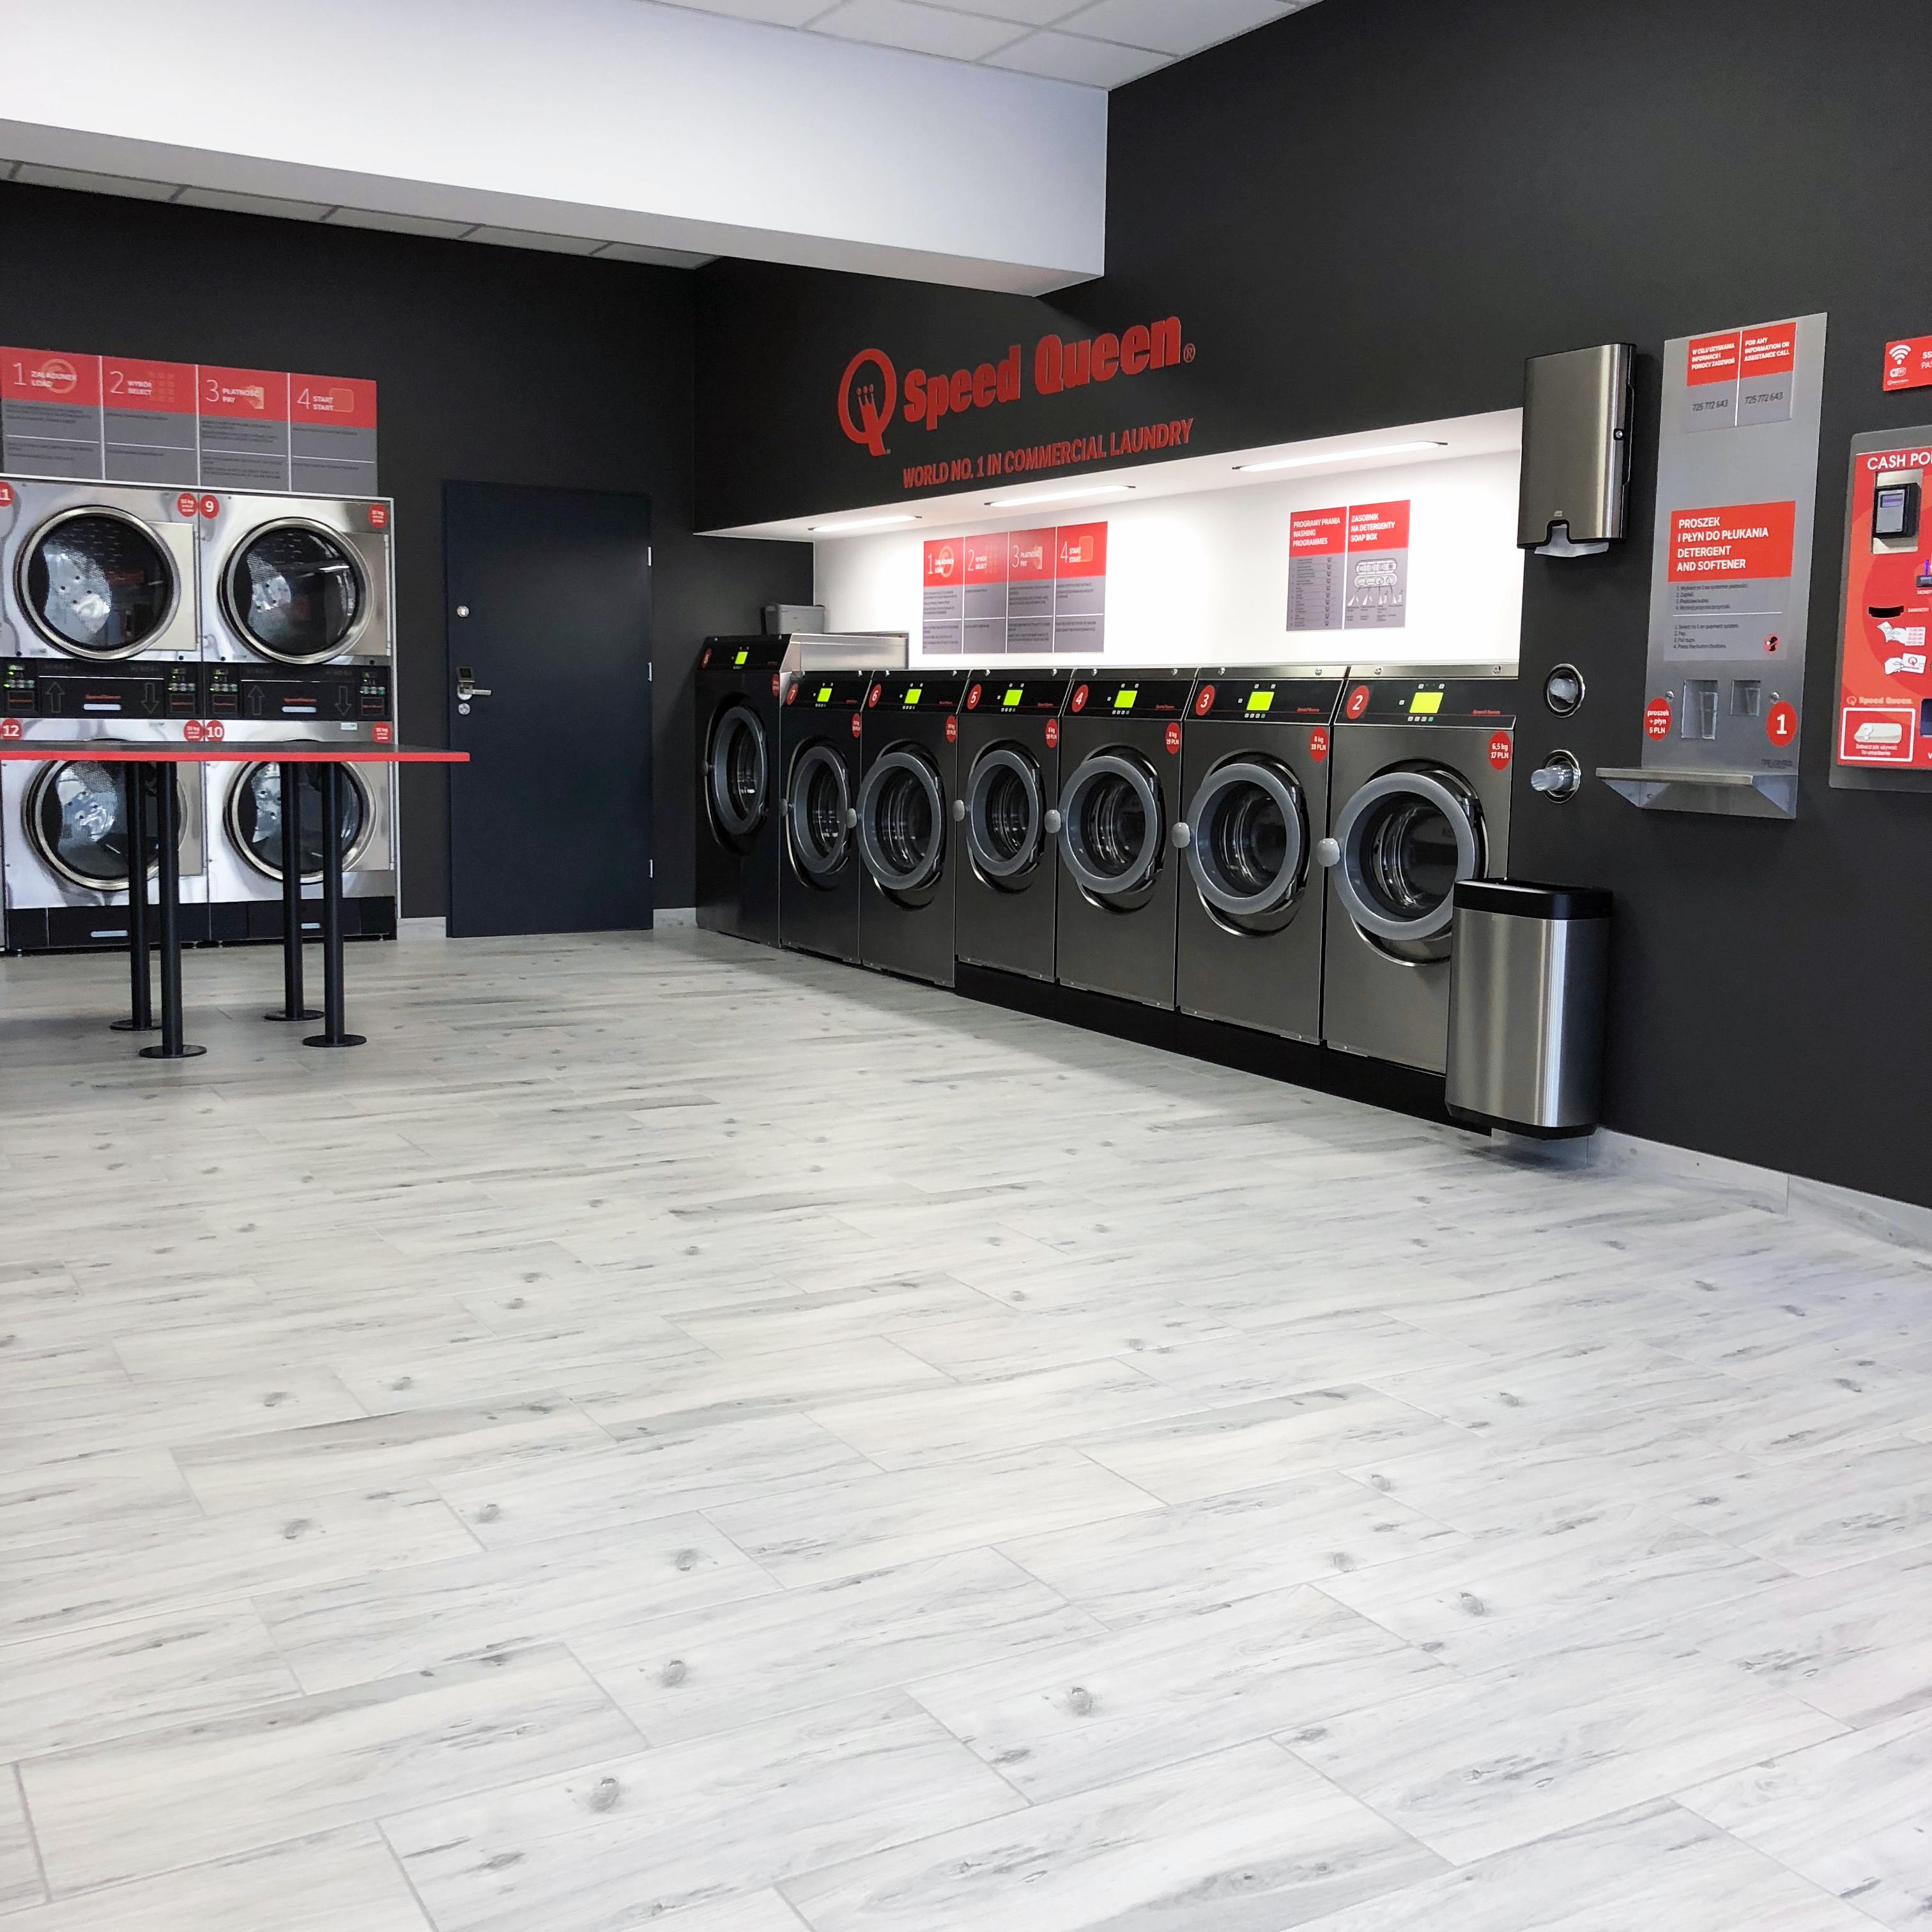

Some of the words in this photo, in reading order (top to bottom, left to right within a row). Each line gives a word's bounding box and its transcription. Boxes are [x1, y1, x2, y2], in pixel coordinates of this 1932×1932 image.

[1745, 342, 1781, 354] INFORMATION
[1744, 351, 1776, 362] ASSISTANCE
[13, 362, 26, 385] 1
[903, 344, 1021, 431] Speed
[1034, 316, 1181, 395] Queen
[110, 371, 125, 394] 2
[206, 379, 219, 402] 3
[297, 388, 310, 409] 4
[312, 395, 334, 404] START
[1745, 395, 1757, 404] 725
[1758, 394, 1769, 402] 772
[312, 403, 334, 411] START
[1692, 403, 1704, 411] 725
[1705, 401, 1715, 410] 772
[903, 463, 948, 489] WORLD
[951, 458, 973, 481] NO.
[977, 456, 985, 478] 1
[987, 452, 1001, 476] IN
[1004, 434, 1107, 473] COMMERCIAL
[1110, 418, 1194, 456] LAUNDRY
[1867, 454, 1906, 470] CASH
[205, 500, 214, 512] 9
[1293, 518, 1321, 528] PROGRAMY
[1321, 517, 1340, 525] PRANIA
[1351, 513, 1379, 523] ZASOBNIK
[1678, 516, 1721, 529] PROSZEK
[1351, 525, 1359, 533] NA
[1360, 521, 1396, 532] DETERGENTY
[1293, 530, 1316, 538] WASHING
[1351, 534, 1365, 542] SOAP
[1366, 533, 1378, 541] BOX
[1678, 533, 1681, 543] I
[1682, 532, 1705, 542] PŁYN
[1706, 530, 1720, 541] DO
[1722, 527, 1769, 540] PŁUKANIA
[1292, 537, 1328, 548] PROGRAMMES
[1011, 545, 1020, 567] 3
[1060, 540, 1068, 564] 4
[1069, 546, 1082, 555] START
[1677, 546, 1731, 558] DETERGENT
[928, 553, 934, 574] 1
[967, 549, 975, 571] 2
[1069, 555, 1082, 564] START
[1676, 562, 1696, 572] AND
[1698, 559, 1746, 571] SOFTENER
[790, 690, 796, 700] 7
[872, 690, 878, 702] 6
[970, 691, 977, 703] 5
[1075, 692, 1084, 705] 4
[1859, 696, 1884, 705] Speed
[1200, 694, 1209, 709] 3
[1352, 695, 1363, 710] 2
[1654, 717, 1666, 726] płyn
[1776, 714, 1788, 735] 1
[3, 724, 19, 736] 12
[206, 726, 223, 738] 10
[1492, 743, 1501, 751] 6,5
[1501, 743, 1508, 752] kg
